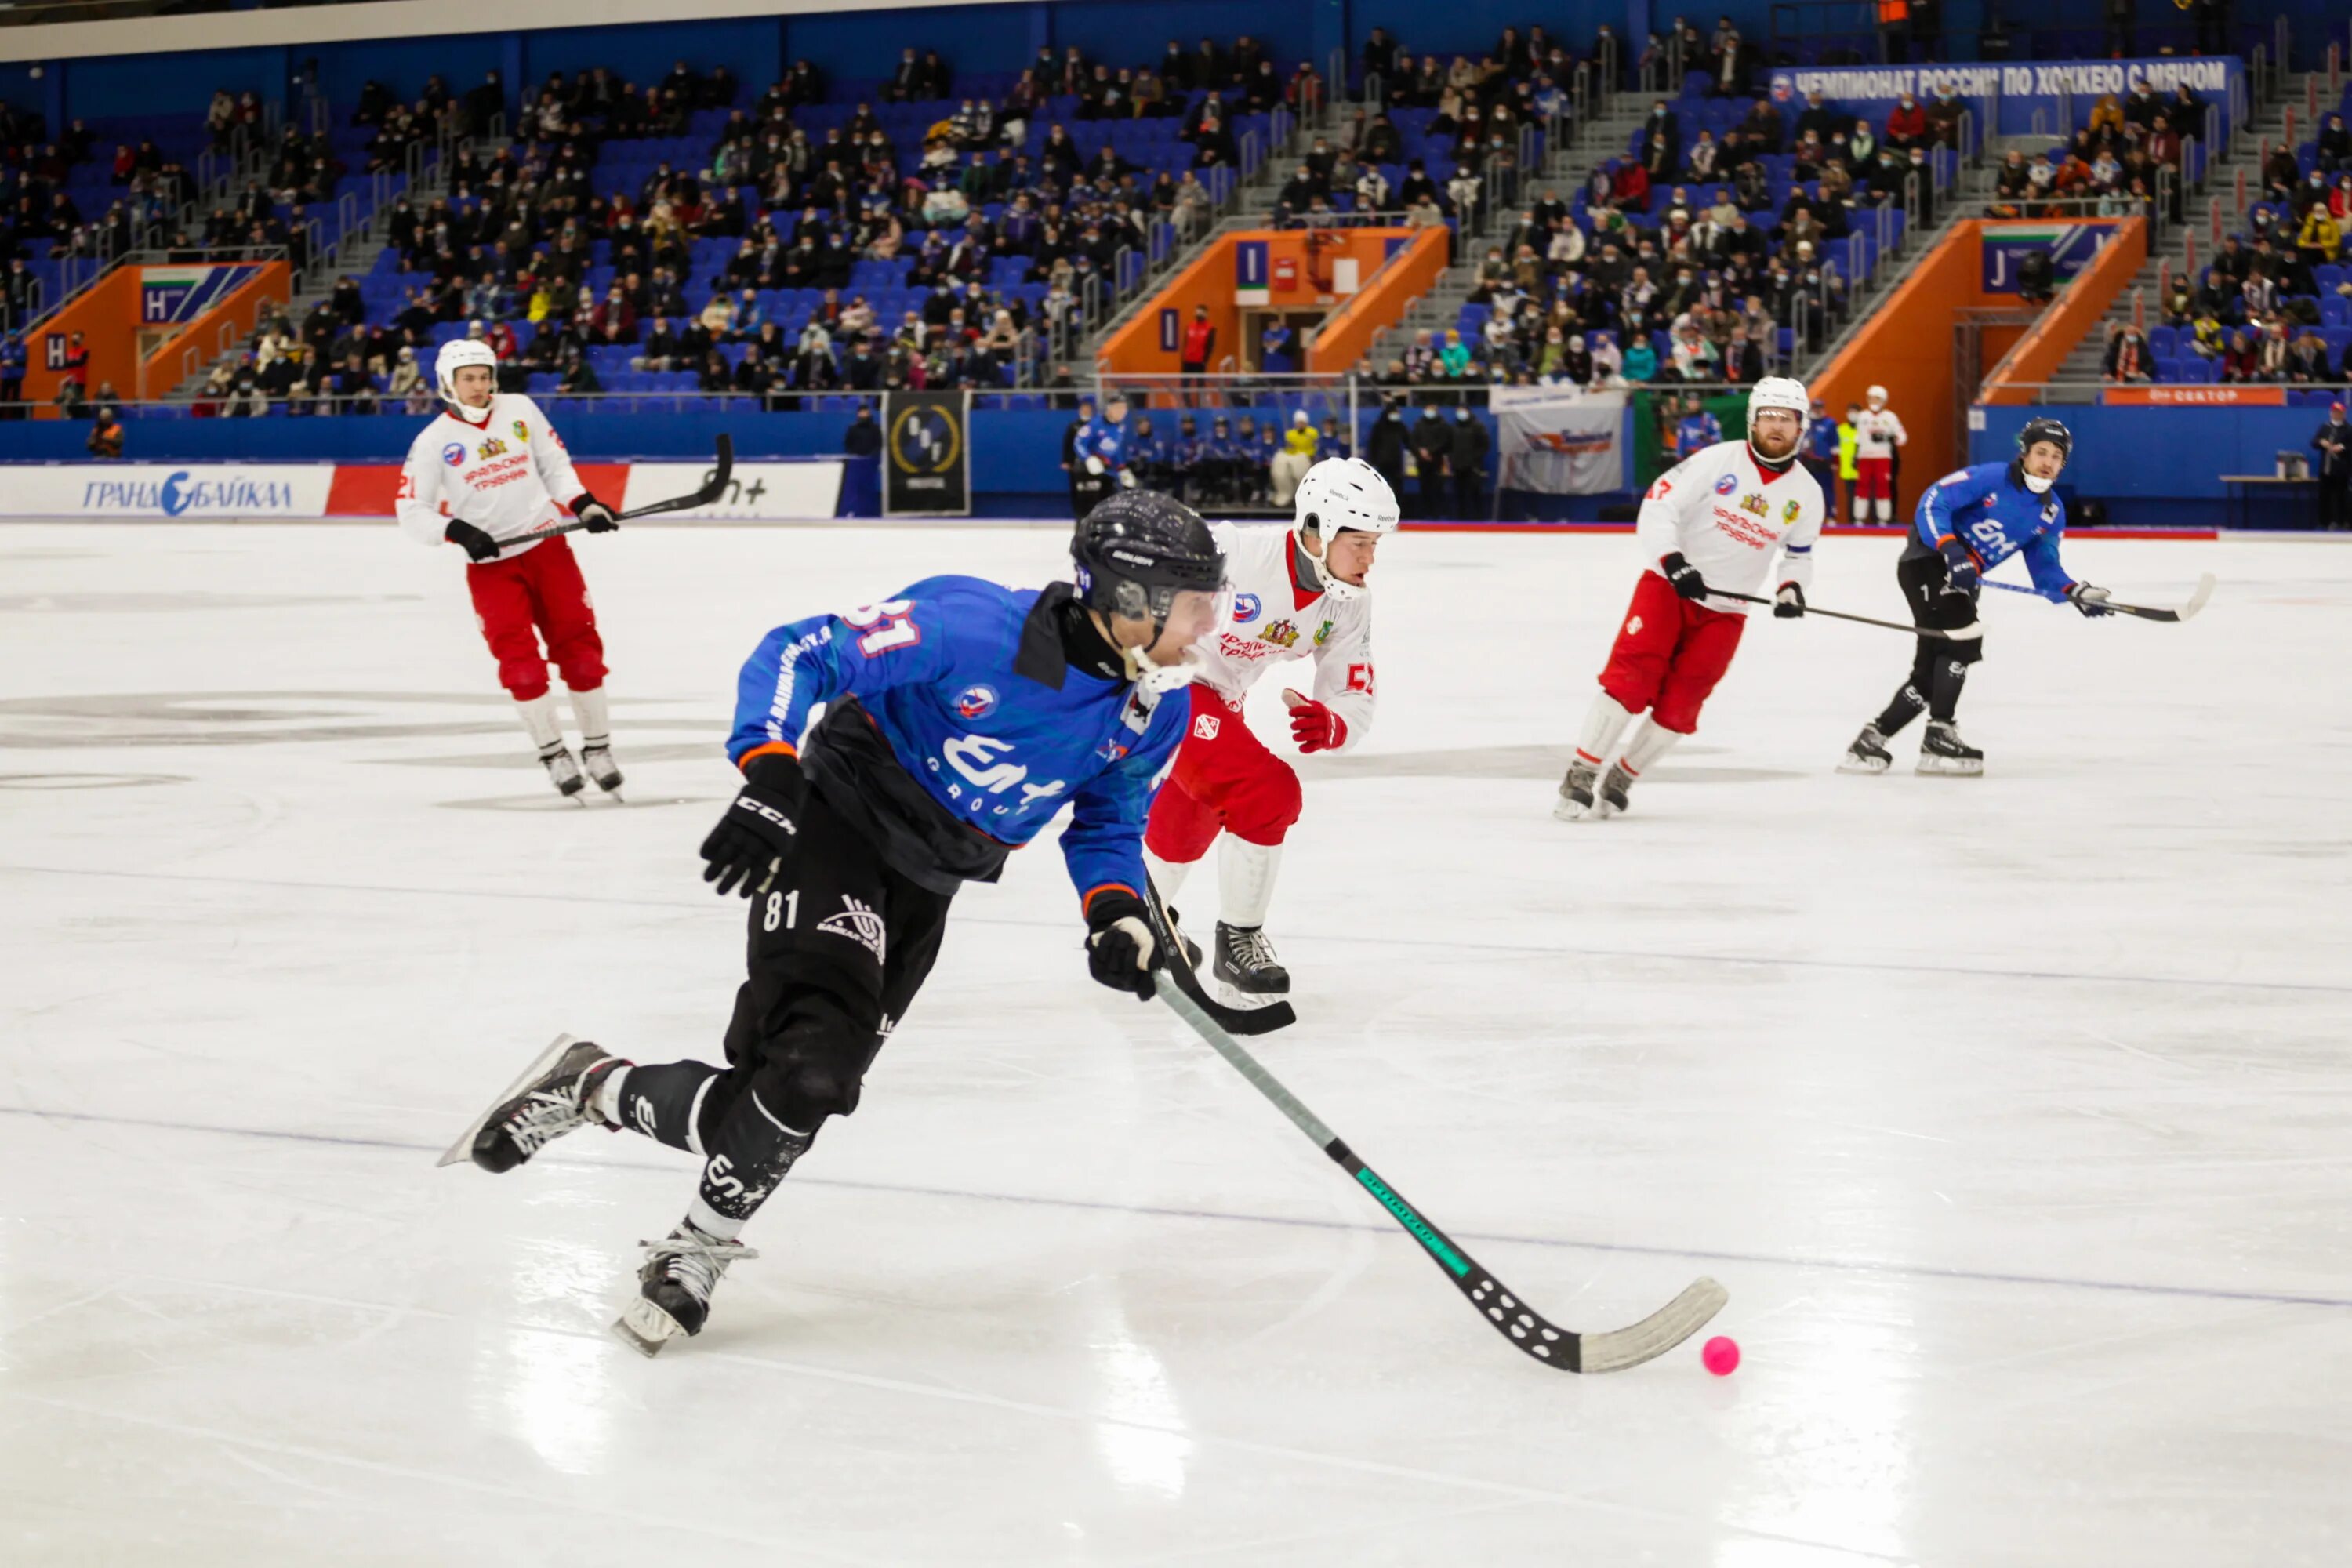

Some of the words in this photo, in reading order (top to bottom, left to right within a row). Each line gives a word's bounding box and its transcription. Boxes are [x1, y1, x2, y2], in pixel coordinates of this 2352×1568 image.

[1795, 71, 1915, 100] ЧЕМПИОНАТ
[1918, 67, 1998, 97] РОССИИ
[2003, 67, 2033, 96] ПО
[2036, 64, 2125, 95] ХОККЕЮ
[2127, 64, 2144, 92] С
[2147, 62, 2226, 91] МЯЧОМ
[1990, 249, 2005, 287] J
[147, 290, 166, 321] H
[47, 337, 65, 368] H
[2174, 390, 2238, 402] СЕКТОР
[83, 481, 158, 509] ГРАНД
[193, 477, 292, 509] БАЙКАЛ
[1714, 505, 1781, 542] УРАЛЬСКИЙ
[736, 796, 797, 837] CCM
[764, 889, 800, 933] 81
